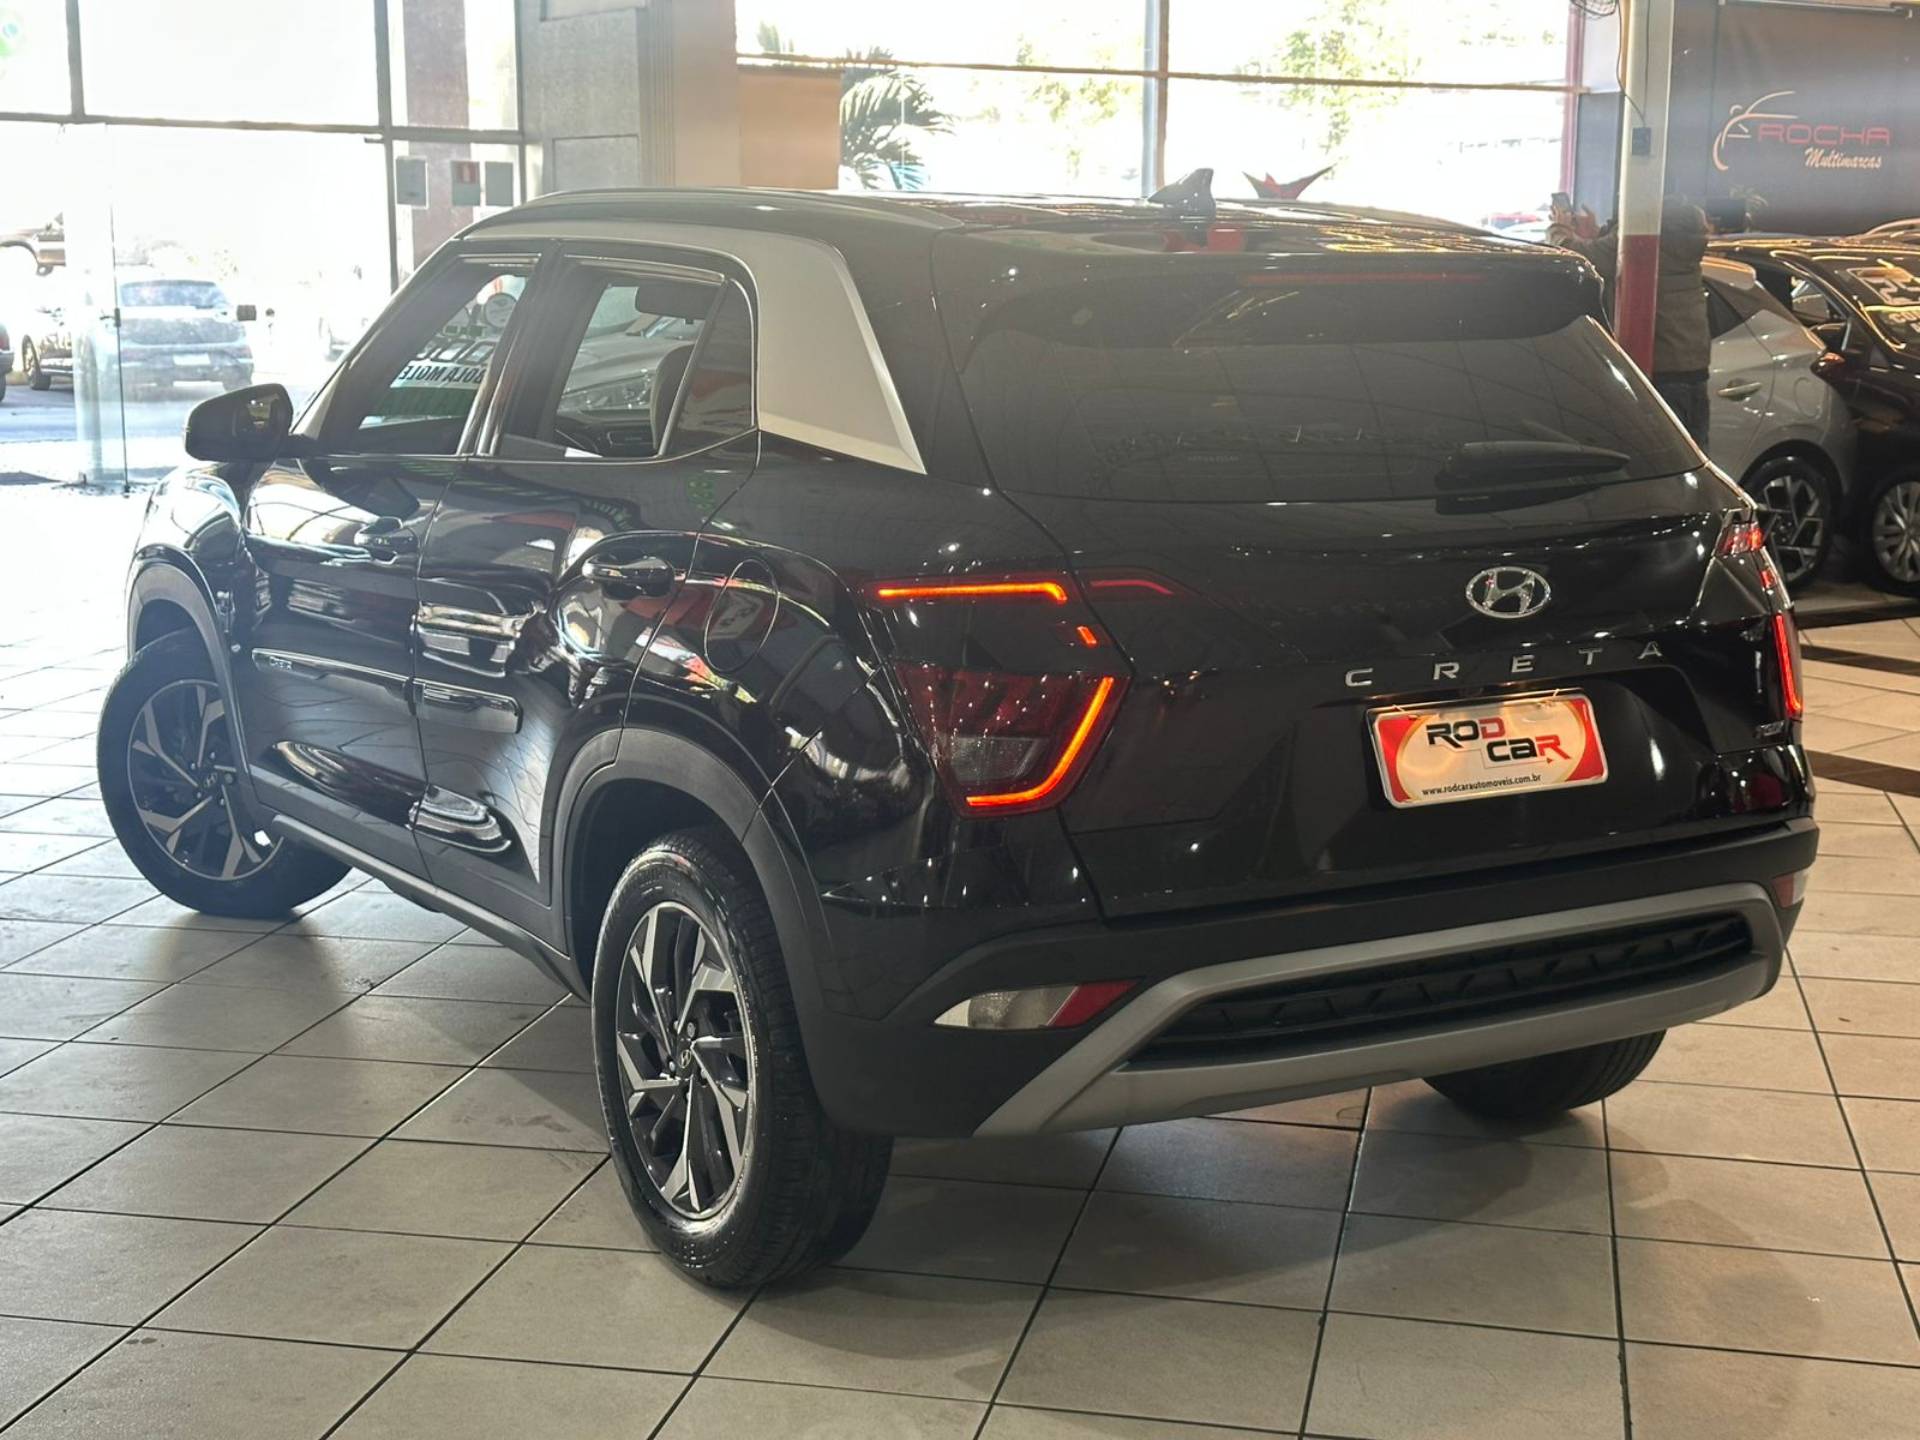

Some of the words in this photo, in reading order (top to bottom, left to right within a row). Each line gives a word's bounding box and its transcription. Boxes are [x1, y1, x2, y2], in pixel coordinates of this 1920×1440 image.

[1757, 123, 1891, 146] ROCHA
[1804, 146, 1883, 169] Multimarcas
[1345, 640, 1663, 687] CRETA
[1425, 717, 1506, 749] ROD
[1422, 773, 1542, 796] www.rodcarautomoveis.com.br
